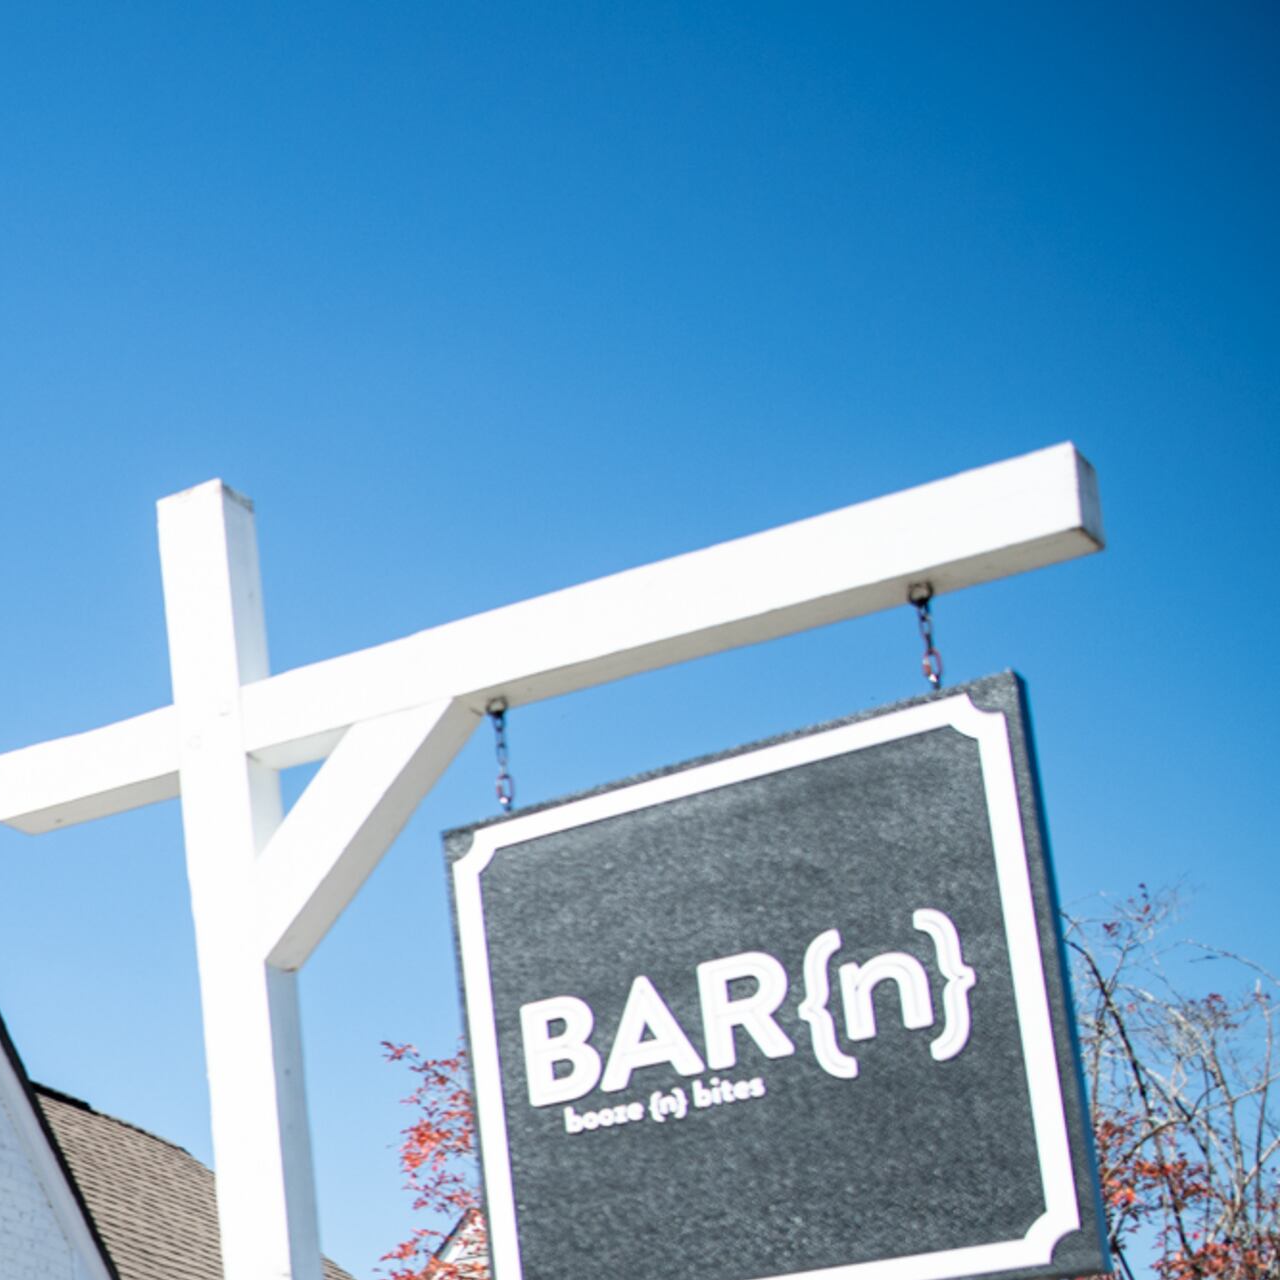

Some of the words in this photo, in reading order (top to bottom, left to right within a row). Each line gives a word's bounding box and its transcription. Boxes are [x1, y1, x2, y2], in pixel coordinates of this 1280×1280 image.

[519, 908, 976, 1108] BAR{n}
[563, 1101, 645, 1134] booze
[691, 1076, 766, 1108] bites
